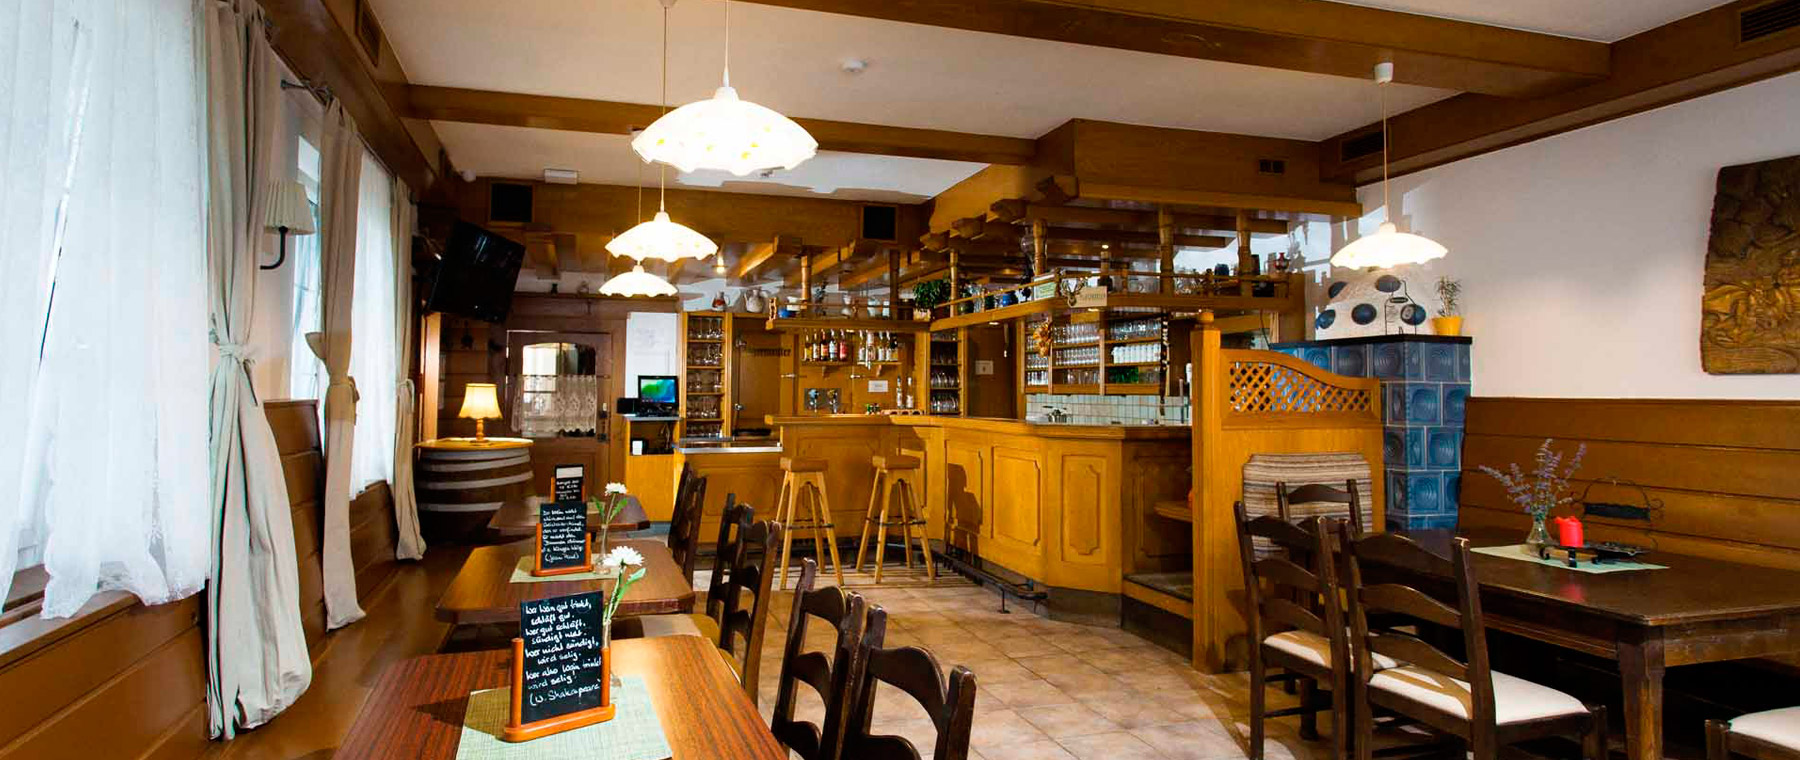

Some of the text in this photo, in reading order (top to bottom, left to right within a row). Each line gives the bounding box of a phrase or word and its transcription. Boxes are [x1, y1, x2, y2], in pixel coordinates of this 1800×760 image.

[556, 601, 568, 613] gut
[530, 613, 556, 626] schläft
[539, 625, 553, 637] gut
[531, 631, 563, 645] sündigt
[541, 643, 564, 654] nicht
[537, 654, 557, 665] wird
[541, 667, 559, 677] also
[527, 679, 548, 690] wird
